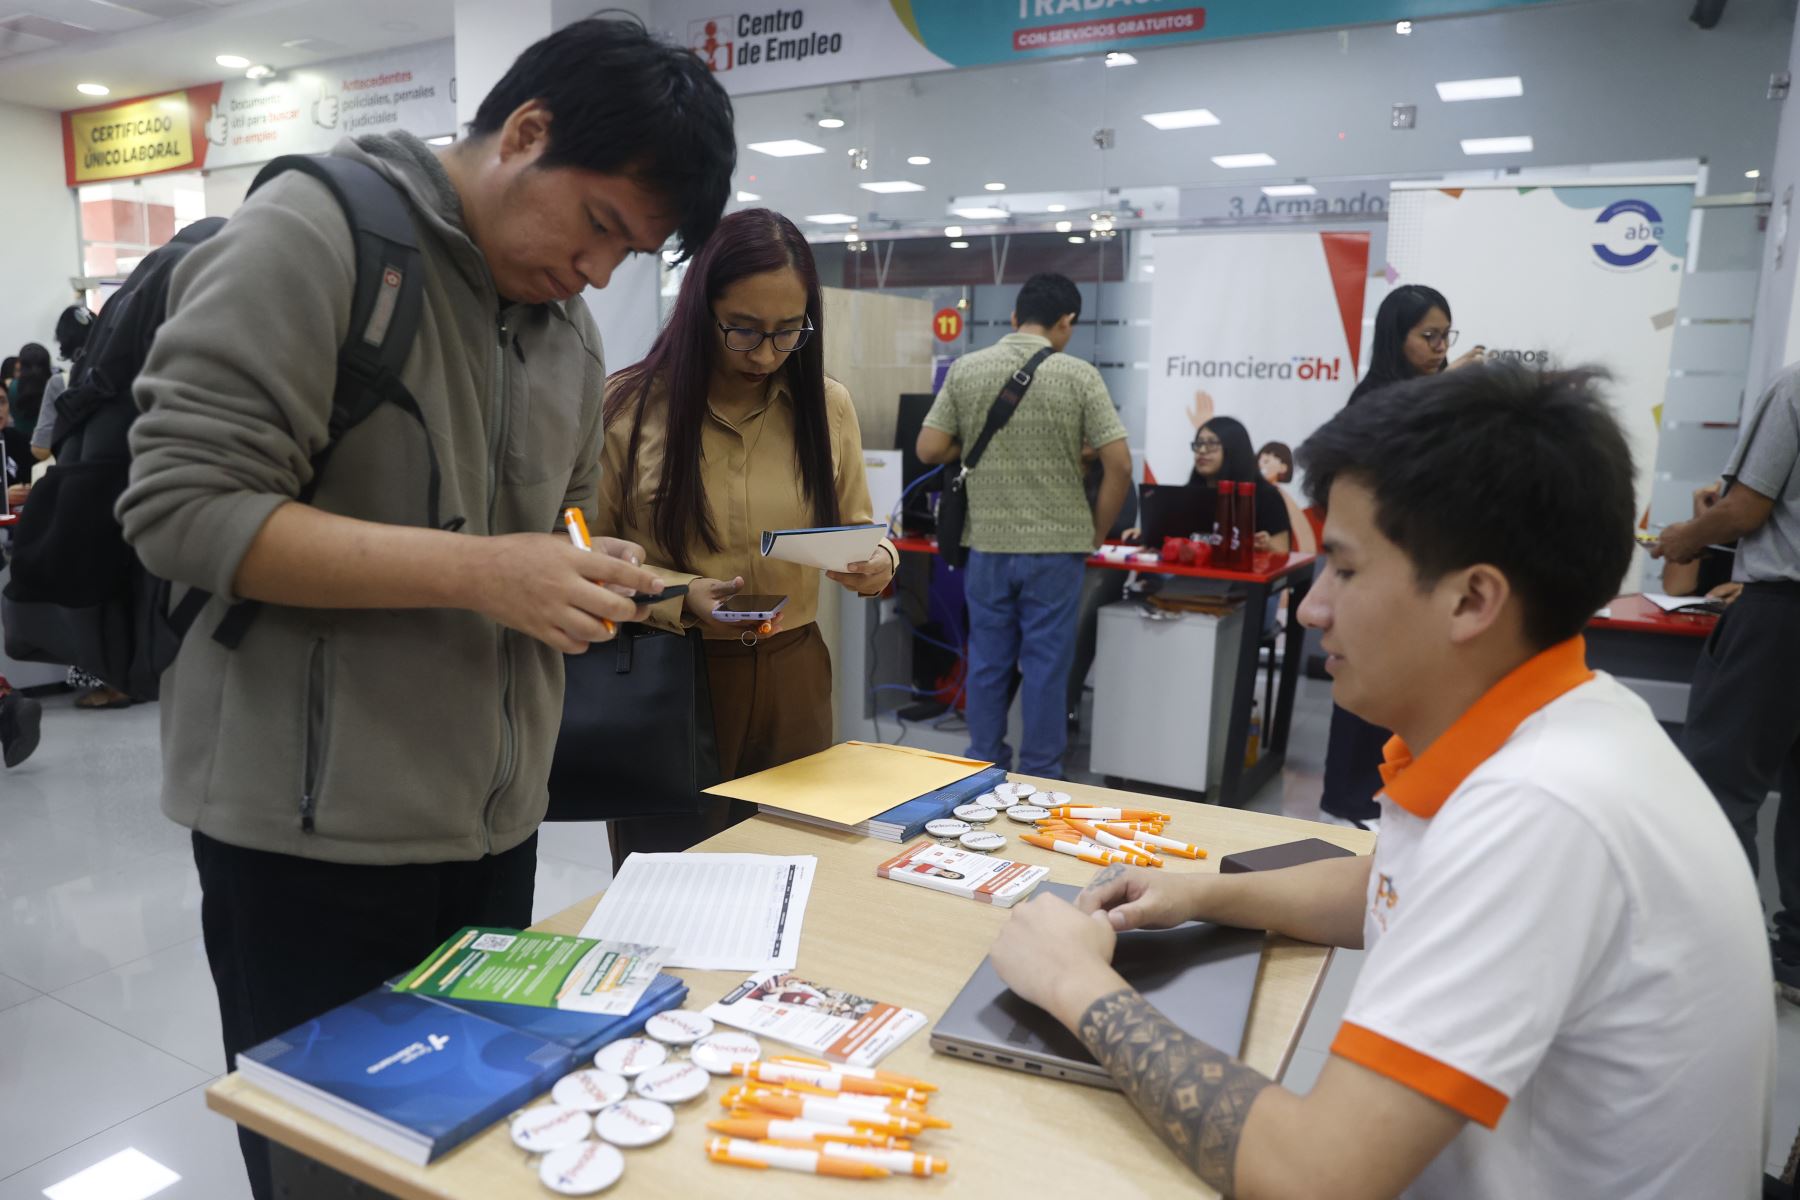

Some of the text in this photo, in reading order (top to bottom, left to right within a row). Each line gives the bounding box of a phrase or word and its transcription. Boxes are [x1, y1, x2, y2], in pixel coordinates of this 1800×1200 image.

[737, 7, 803, 38] Centro
[1018, 14, 1194, 46] CON SERVICIOS GRATUITOS
[737, 31, 842, 67] de Empleo
[91, 115, 172, 143] CERTIFICADO
[83, 140, 181, 169] ÚNICO LABORAL
[1624, 222, 1664, 241] abe
[938, 315, 957, 335] 11
[1166, 355, 1292, 379] Financiera
